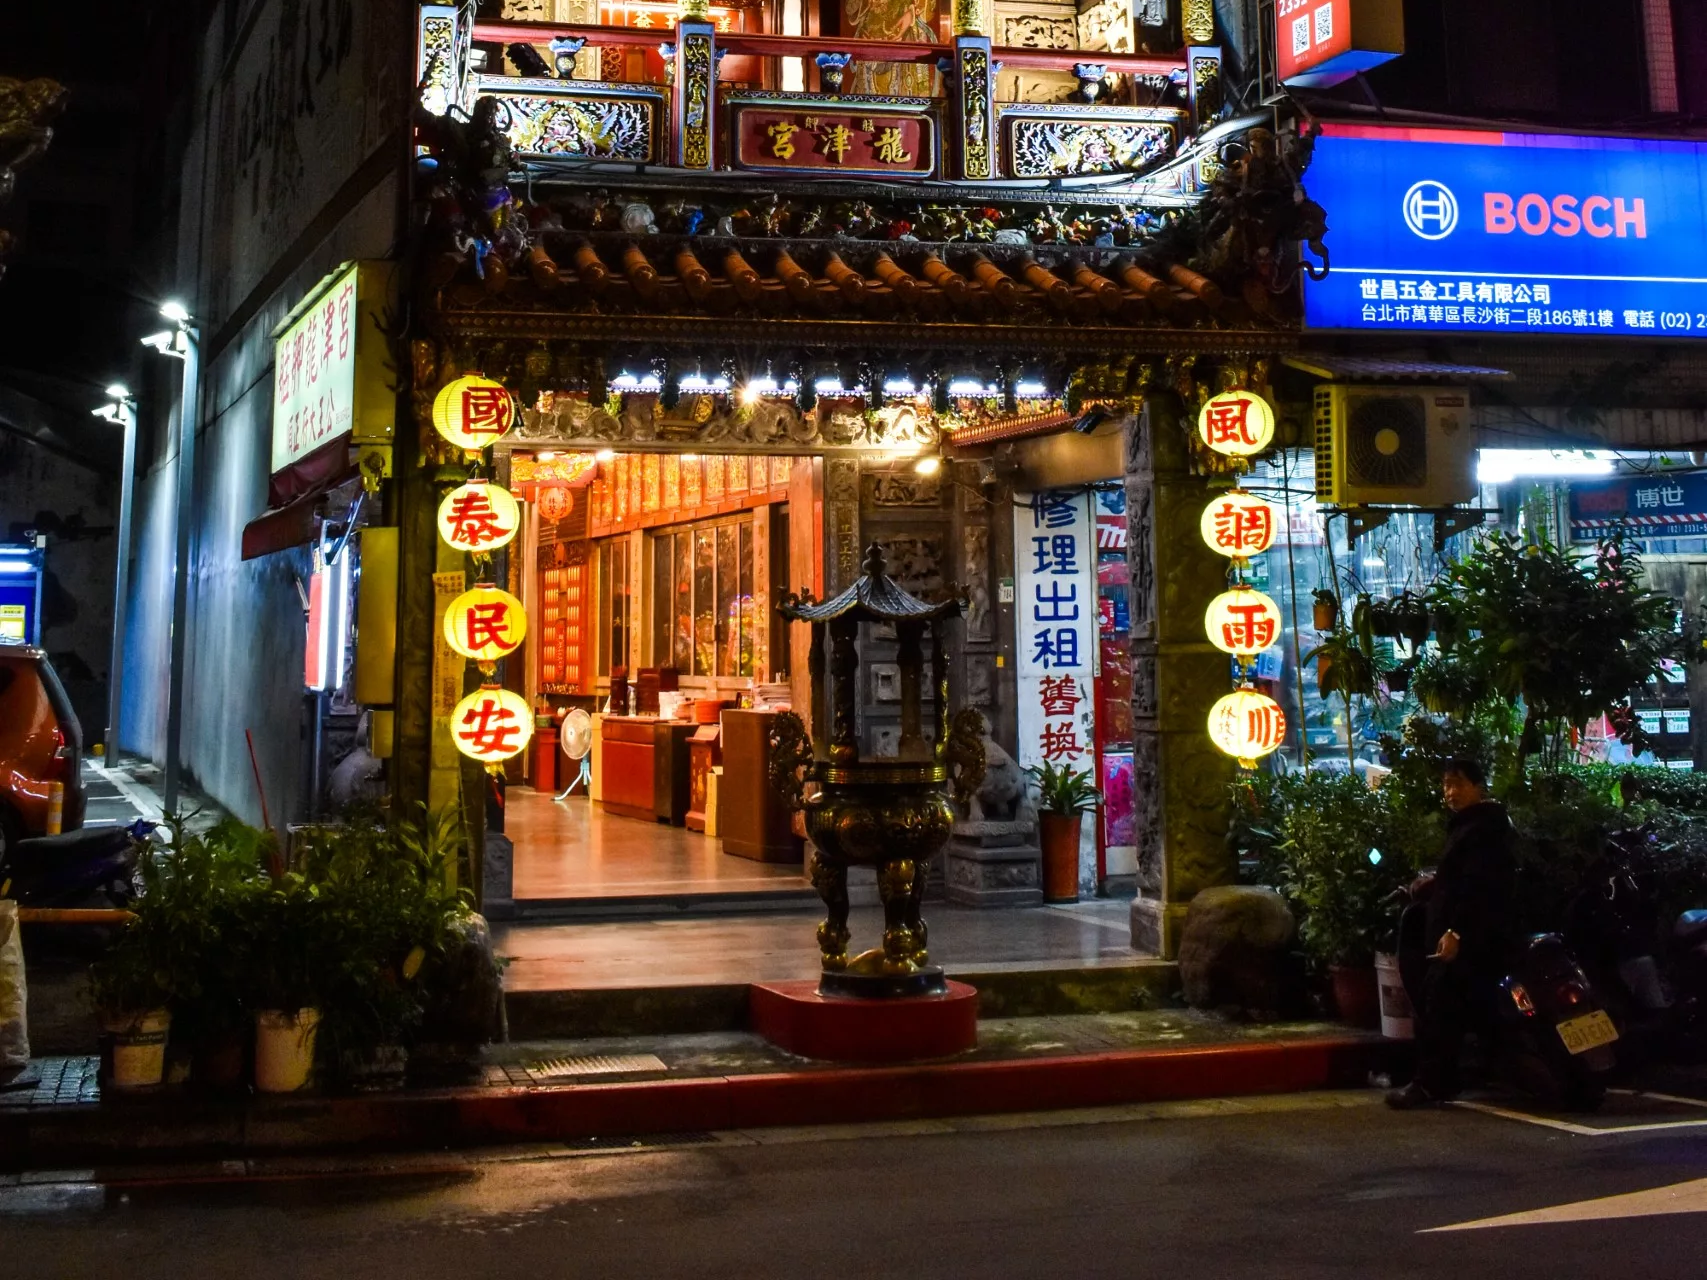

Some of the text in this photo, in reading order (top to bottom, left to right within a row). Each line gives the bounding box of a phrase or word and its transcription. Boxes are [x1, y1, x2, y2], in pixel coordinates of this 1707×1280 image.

[1484, 192, 1647, 239] BOSCH
[1359, 279, 1551, 305] 世昌五金工具有限公司
[1623, 310, 1655, 328] 電話
[1660, 312, 1691, 330] (02)
[1634, 485, 1685, 509] 博世
